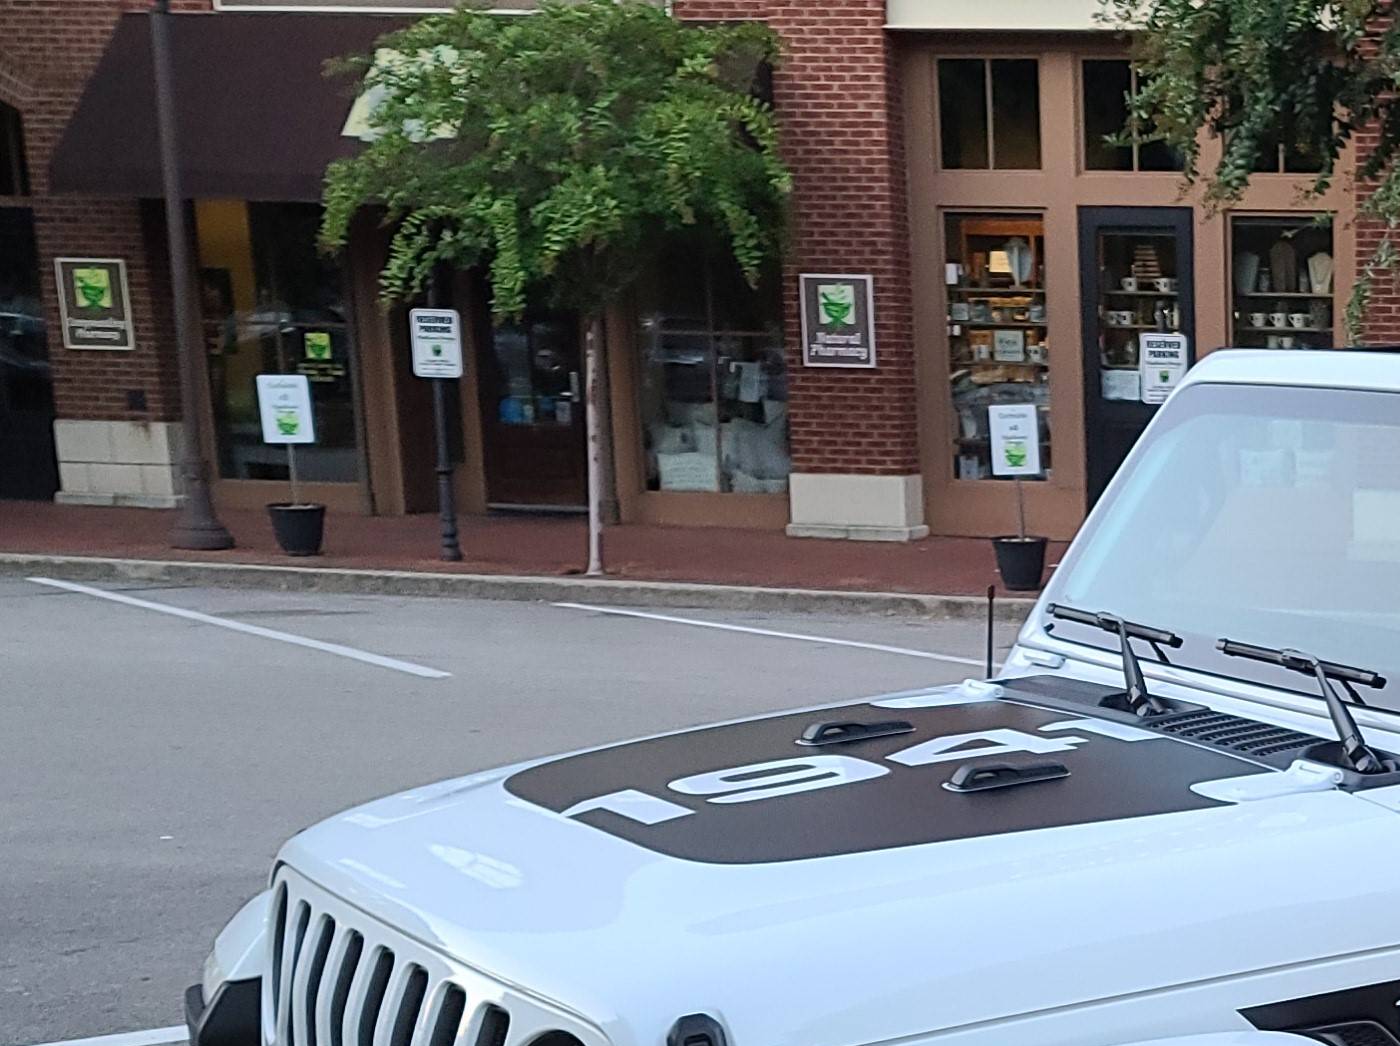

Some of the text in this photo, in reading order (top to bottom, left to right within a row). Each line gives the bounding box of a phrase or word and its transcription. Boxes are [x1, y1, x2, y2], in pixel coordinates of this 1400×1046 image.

[809, 344, 868, 360] Pharmacy
[1148, 350, 1180, 359] PARKING
[556, 717, 1168, 825] 1941
